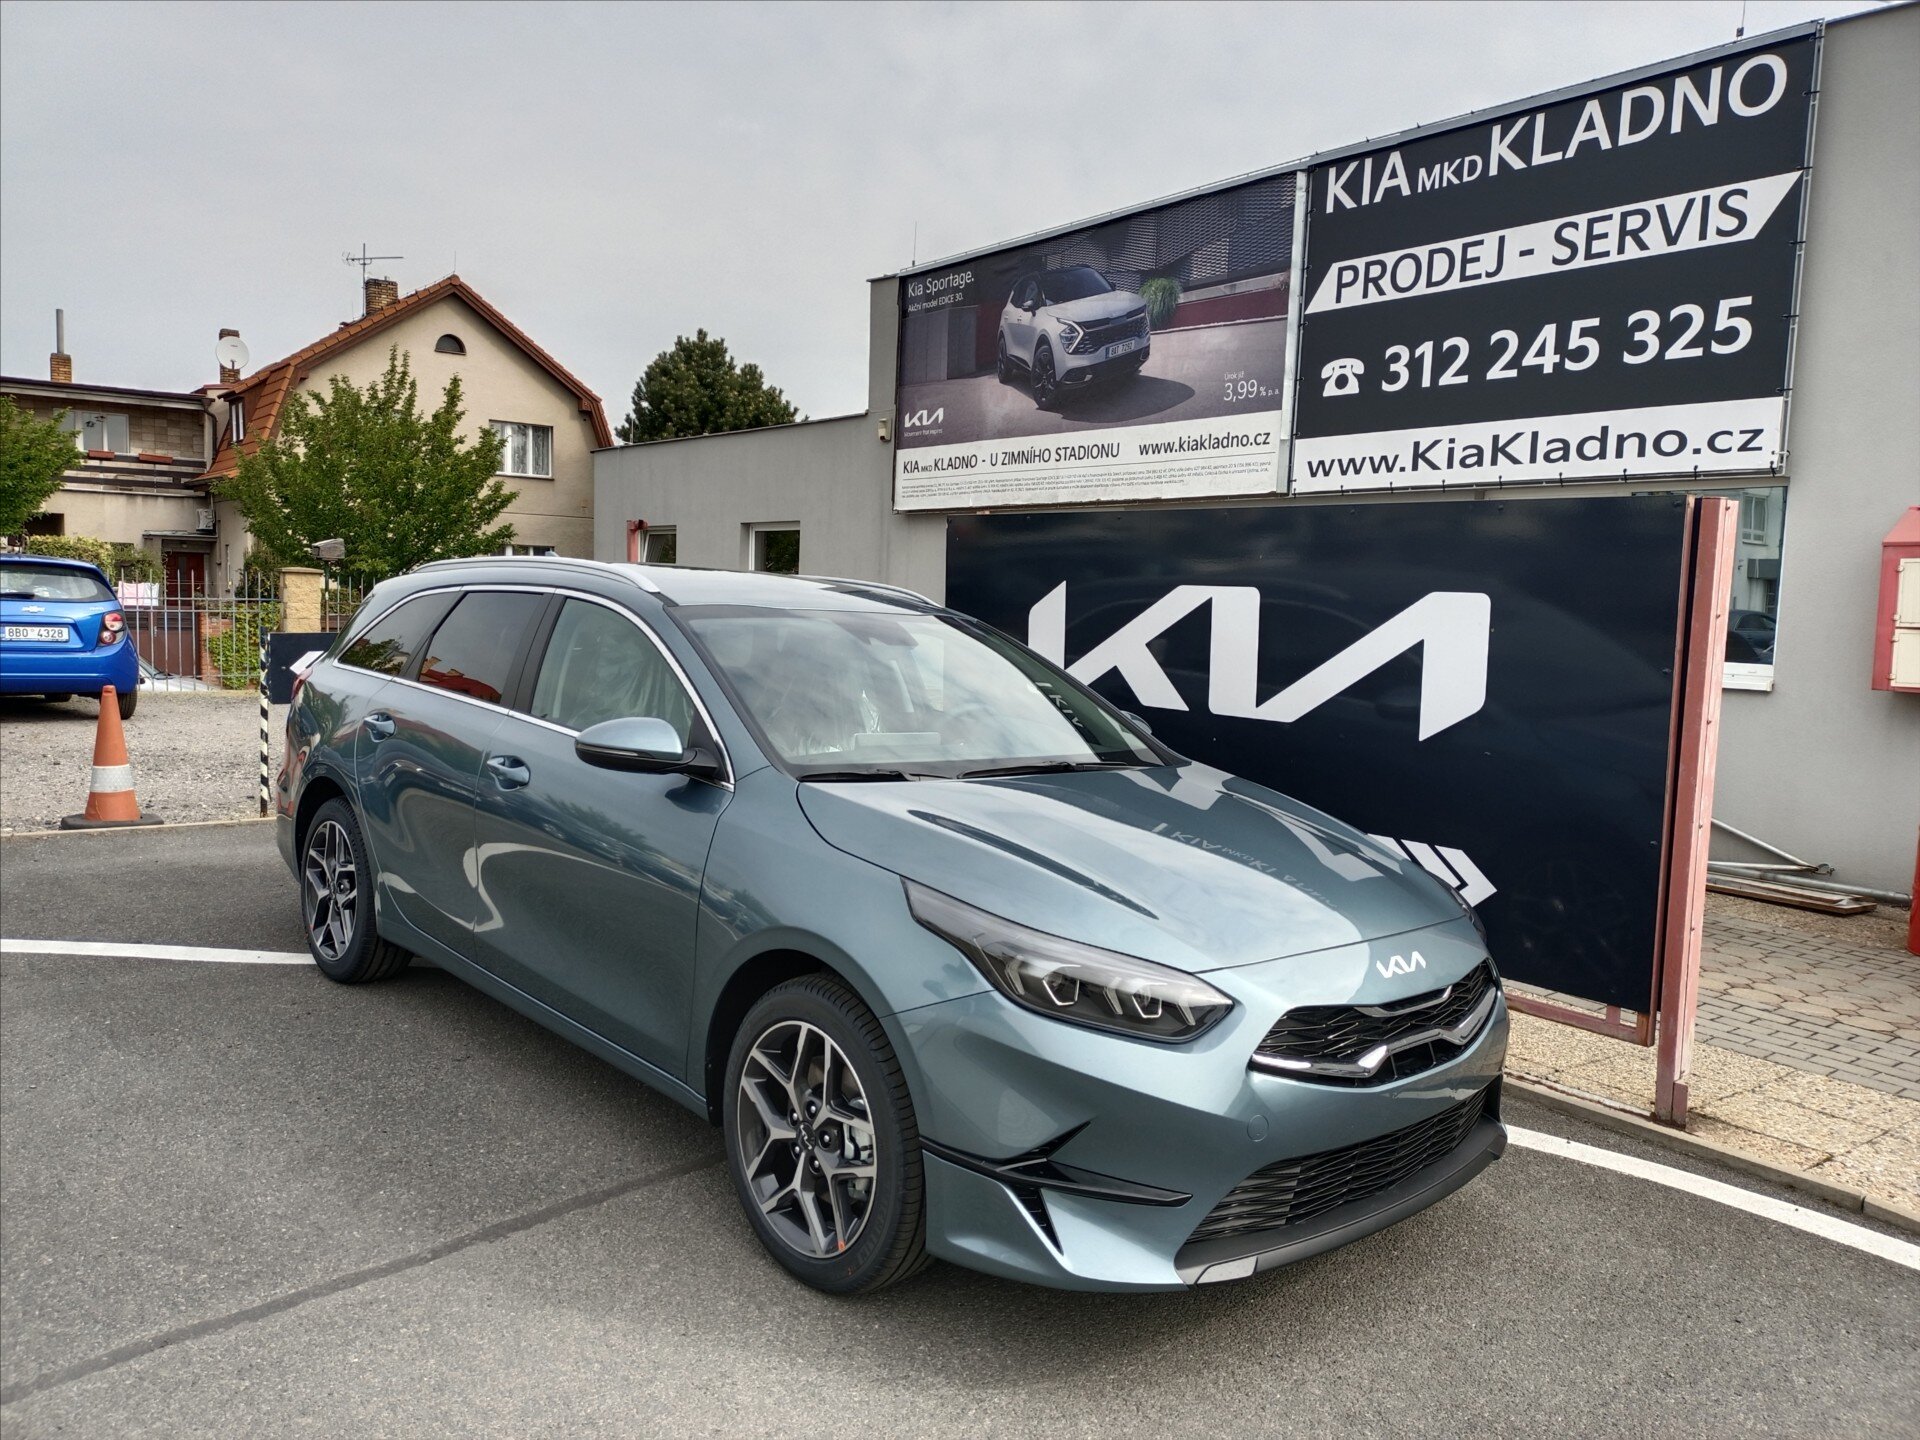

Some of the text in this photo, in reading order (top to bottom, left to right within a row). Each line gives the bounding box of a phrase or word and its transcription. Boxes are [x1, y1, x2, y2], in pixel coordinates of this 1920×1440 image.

[1326, 53, 1788, 213] KIA MKD KLADNO
[1335, 187, 1749, 304] PRODEJ - SERVIS
[908, 271, 975, 298] Kia Sportage.
[1381, 296, 1754, 393] 312 245 325
[1223, 380, 1258, 402] 3,99
[904, 407, 944, 428] KIA
[903, 460, 919, 474] KIA
[920, 464, 933, 473] MKD
[933, 454, 978, 472] KLADNO
[990, 452, 998, 466] U
[1001, 446, 1052, 466] ZIMNÍHO
[1055, 442, 1120, 462] STADIONU
[1139, 431, 1271, 456] www.kiakladno.cz
[1307, 426, 1765, 478] www.KiaKladno.cz
[37, 628, 64, 638] 4328
[1027, 580, 1491, 741] KIA
[1375, 950, 1427, 979] KIA
